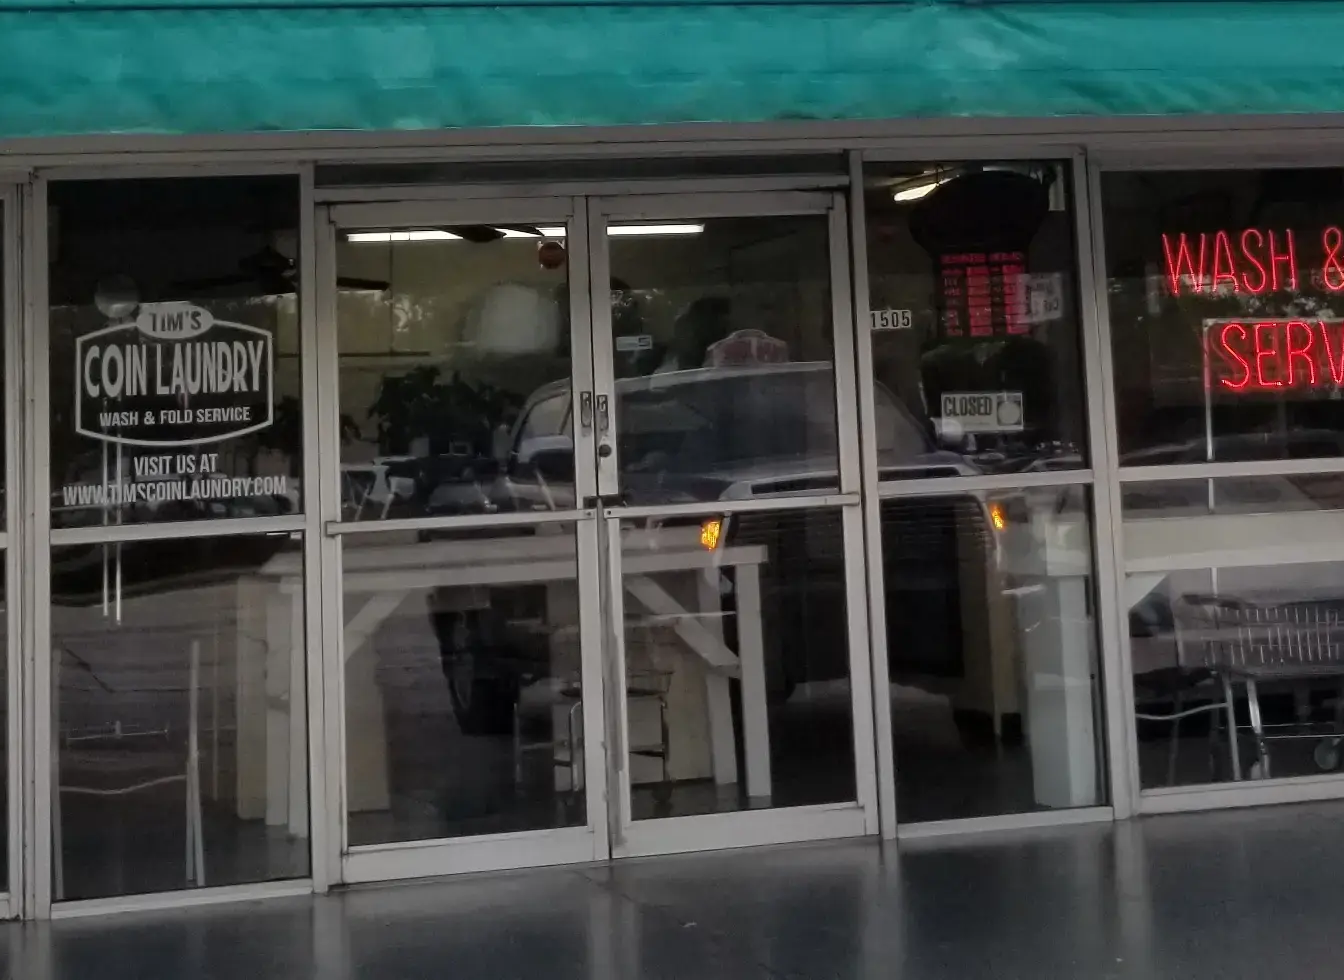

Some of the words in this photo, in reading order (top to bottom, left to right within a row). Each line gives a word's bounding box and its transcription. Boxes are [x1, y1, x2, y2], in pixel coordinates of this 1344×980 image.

[1161, 228, 1297, 295] WASH
[149, 310, 202, 332] TIM'S
[870, 311, 911, 329] 1505
[84, 343, 148, 398] COIN
[155, 340, 265, 396] LAUNDRY
[99, 411, 139, 427] WASH
[143, 410, 156, 425] &
[160, 409, 193, 425] FOLD
[196, 406, 251, 423] SERVICE
[943, 396, 993, 416] CLOSED
[133, 456, 173, 477] VISIT
[176, 454, 196, 474] US
[199, 453, 219, 473] AT
[62, 475, 288, 506] WWW.TIMSCOINLAUNDRY.COM
